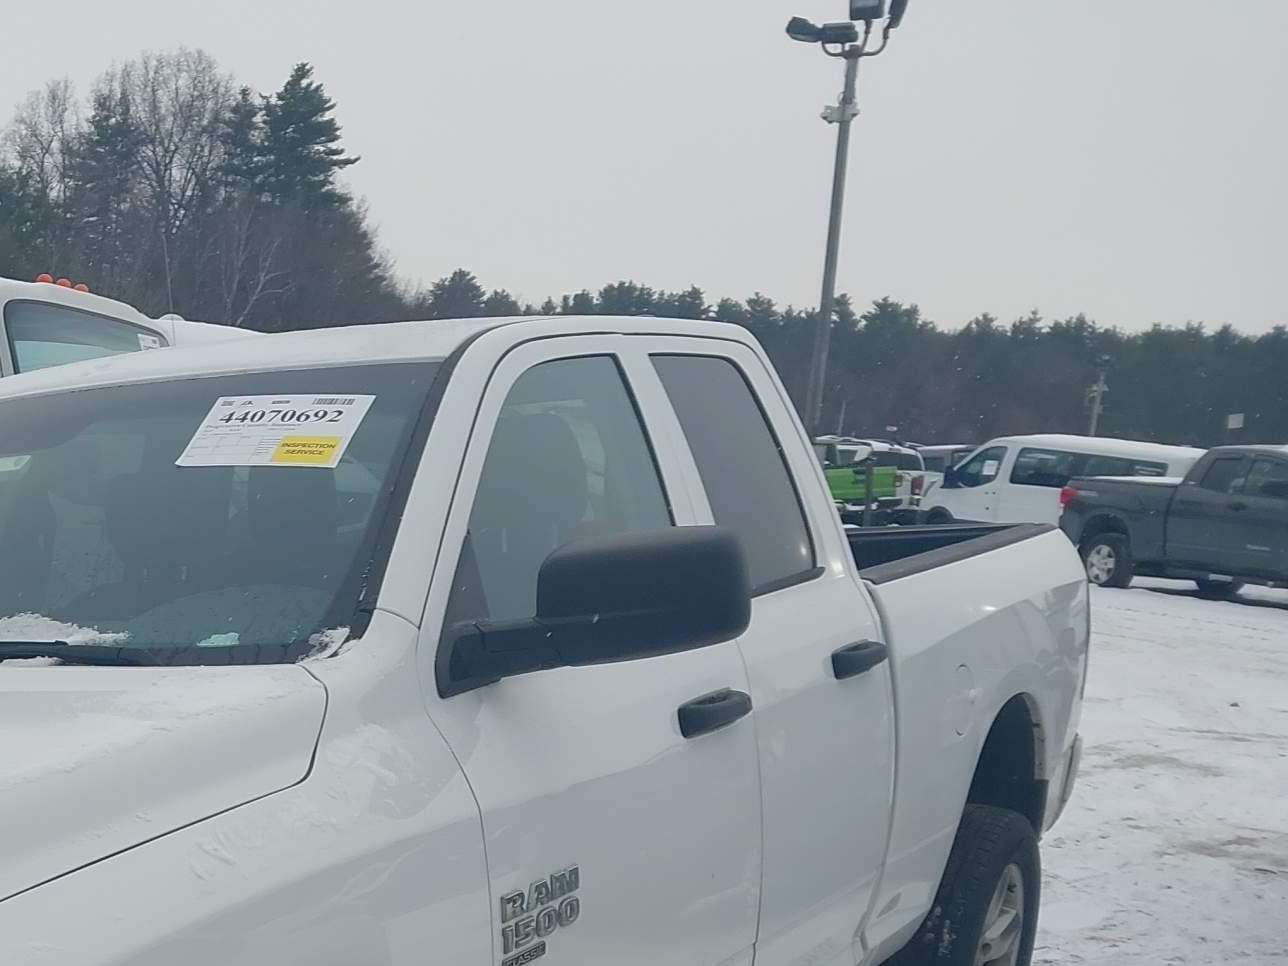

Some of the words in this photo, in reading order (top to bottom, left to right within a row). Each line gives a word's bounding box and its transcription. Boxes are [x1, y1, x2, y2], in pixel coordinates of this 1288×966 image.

[219, 409, 345, 424] 44070692
[280, 442, 337, 450] INSPECTION
[500, 864, 580, 924] RAM
[501, 896, 580, 955] 1500
